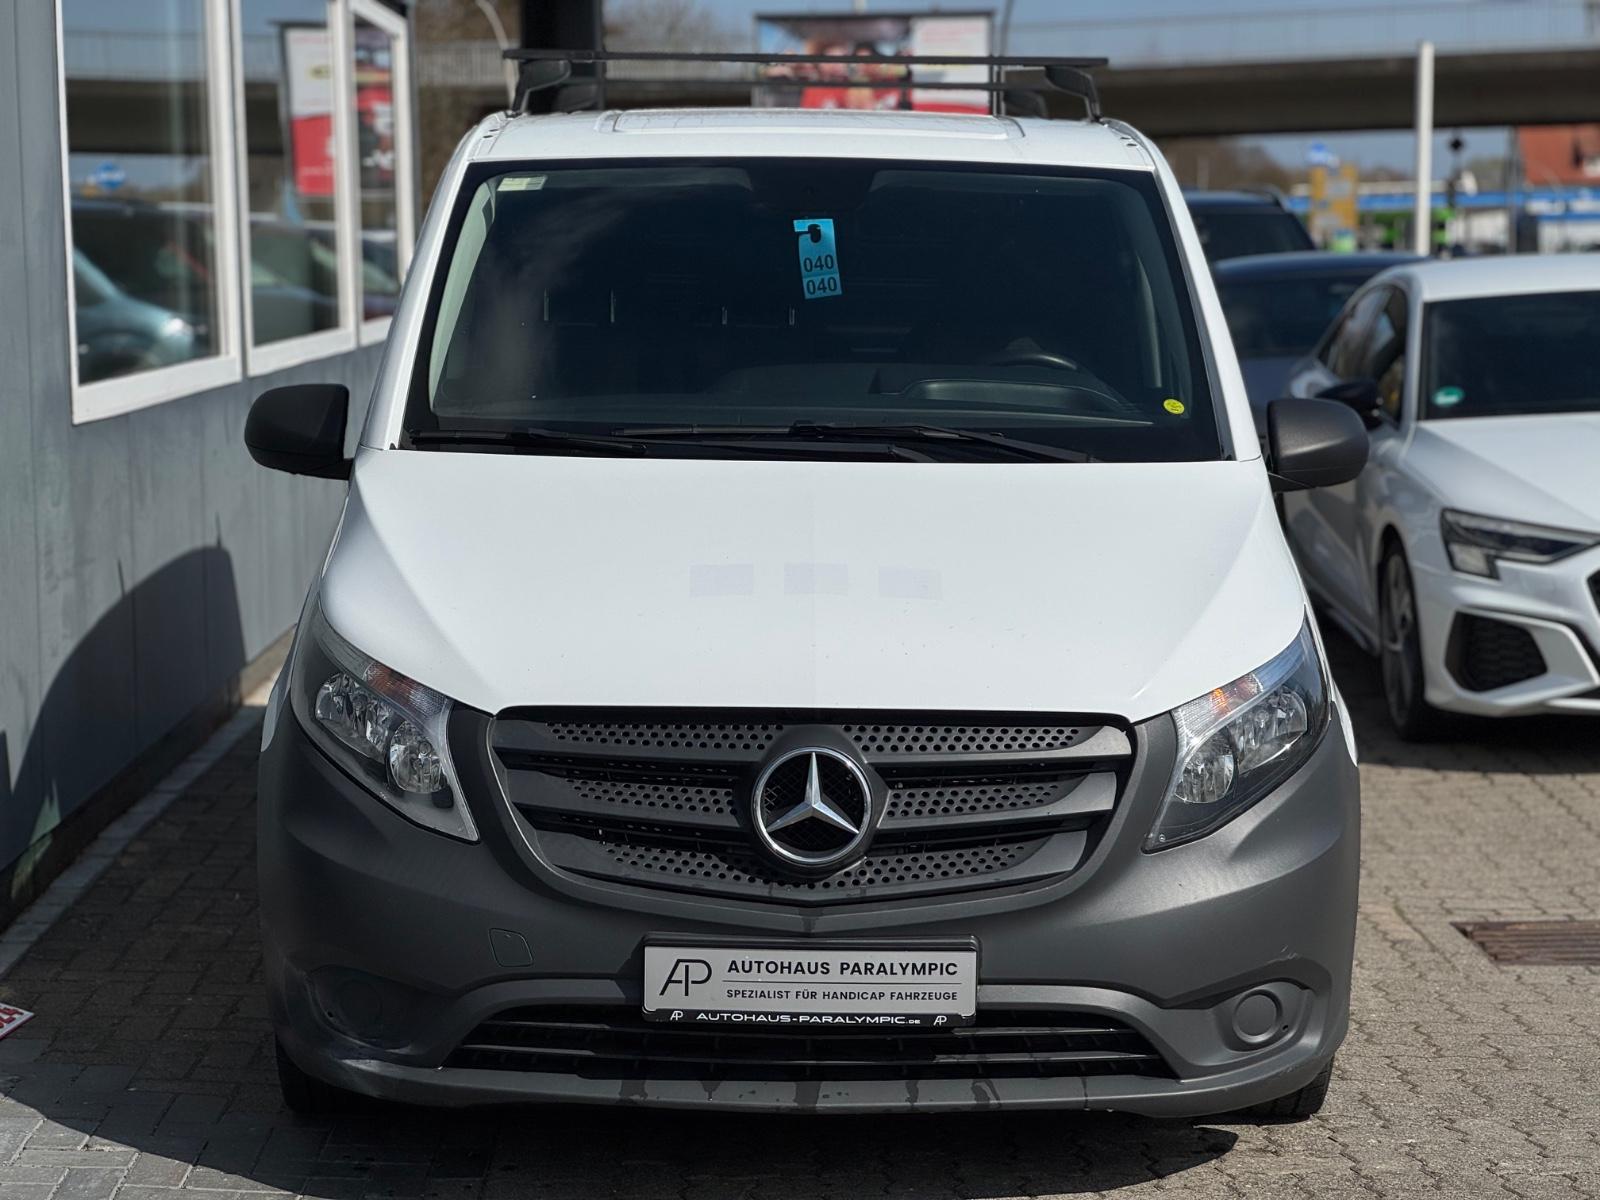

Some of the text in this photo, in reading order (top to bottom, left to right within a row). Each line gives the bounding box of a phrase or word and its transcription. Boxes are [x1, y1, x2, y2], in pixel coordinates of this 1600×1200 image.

[803, 254, 834, 272] 040
[806, 276, 837, 295] 040
[727, 960, 958, 976] AUTOHAUS PARALYMPIC
[726, 988, 958, 1001] SPEZIALIST FÜR HANDICAP FAHRZEUGE
